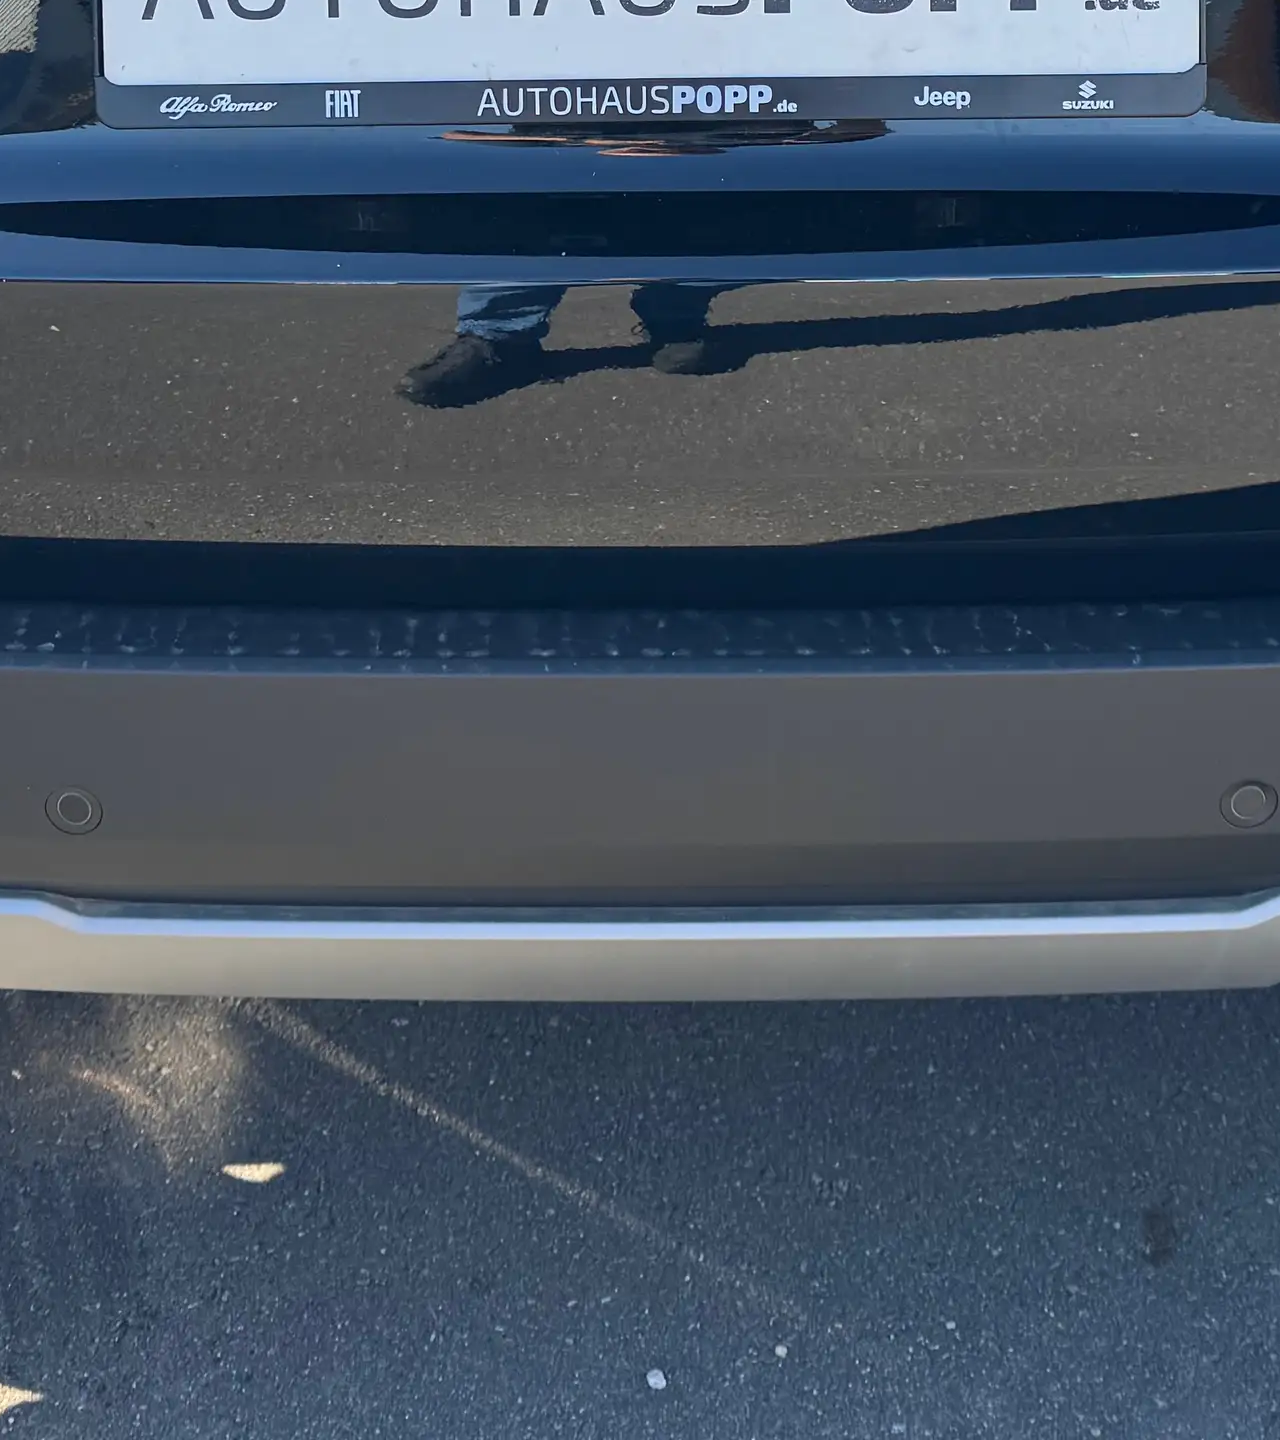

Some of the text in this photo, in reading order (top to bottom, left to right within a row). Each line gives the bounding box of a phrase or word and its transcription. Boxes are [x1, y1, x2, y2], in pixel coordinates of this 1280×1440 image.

[159, 93, 278, 120] Alfa Romeo
[324, 89, 362, 118] FIAT
[476, 84, 799, 117] AUTOHAUSPOPP.de
[913, 85, 971, 110] Jeep
[1062, 99, 1115, 110] SUZUKI
